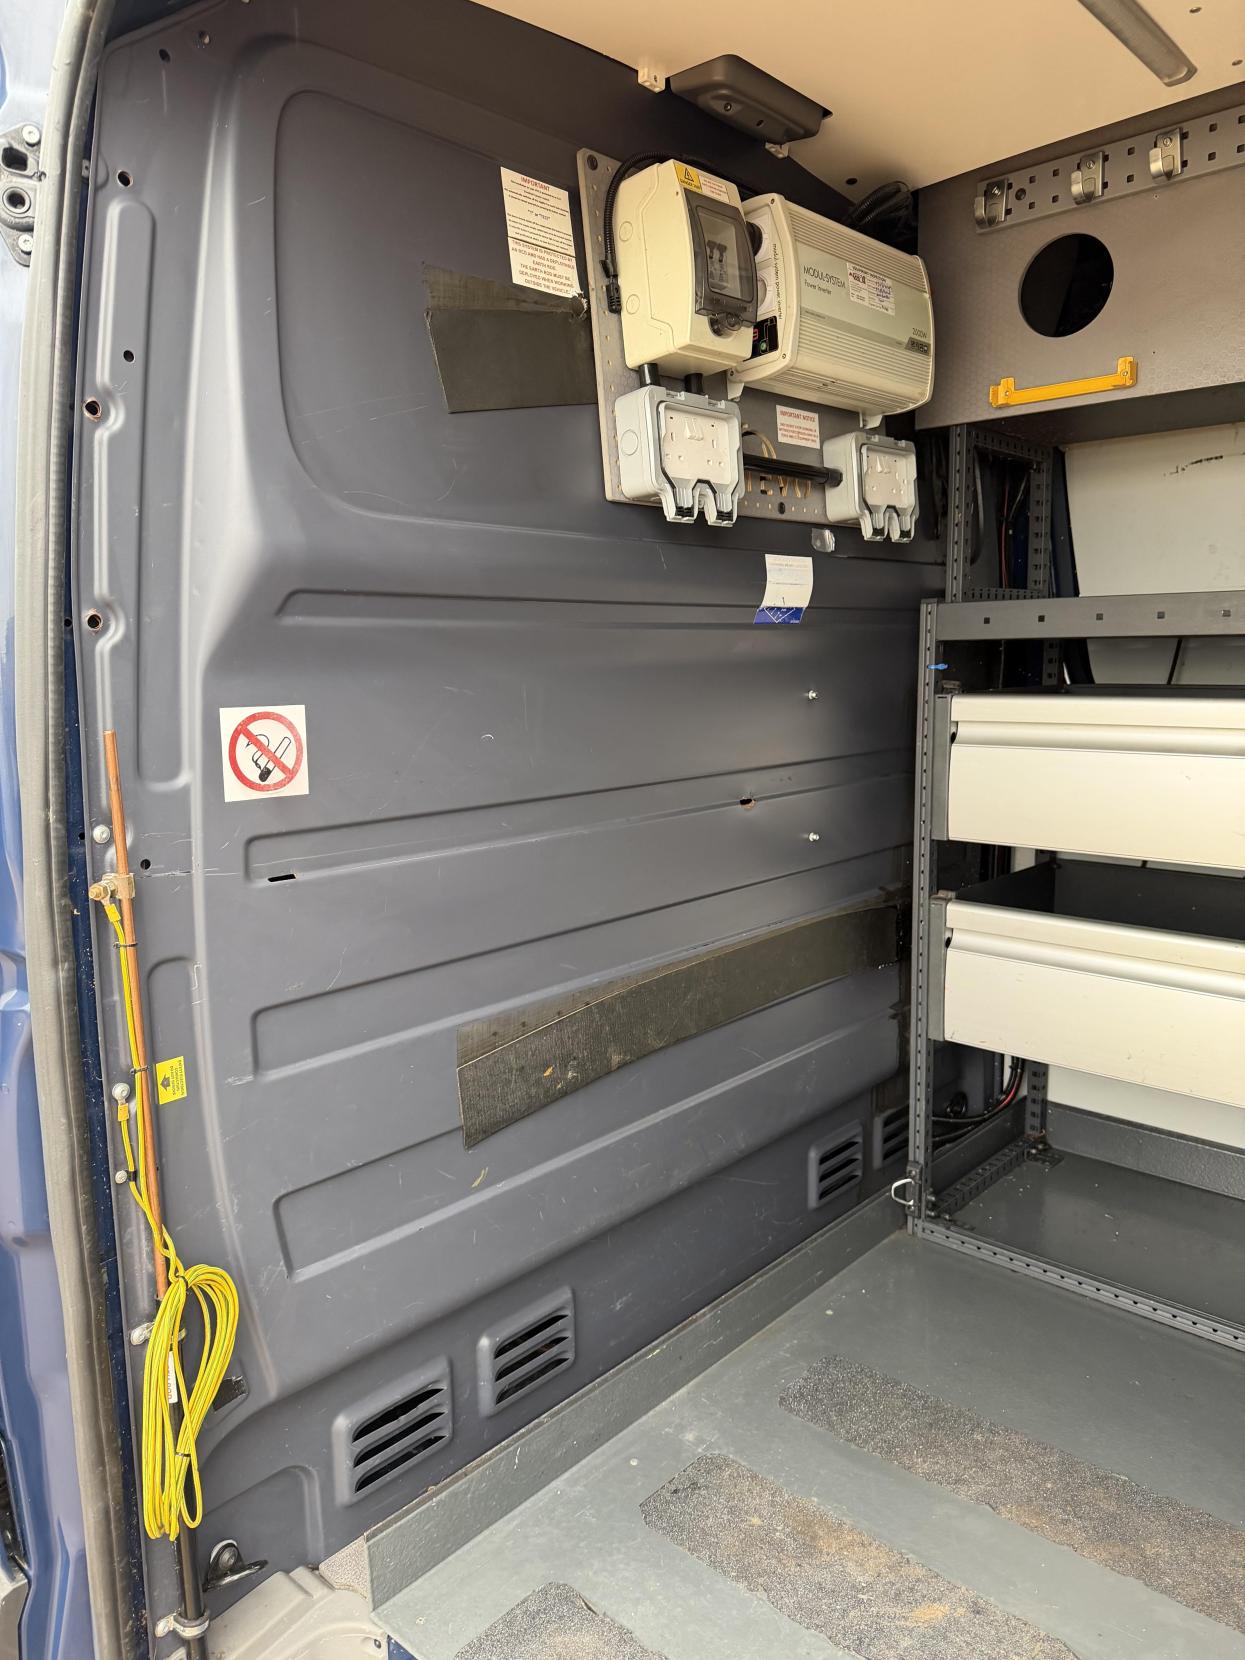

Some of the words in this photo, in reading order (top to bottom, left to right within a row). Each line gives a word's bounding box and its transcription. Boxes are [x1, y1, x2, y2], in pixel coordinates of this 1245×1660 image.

[520, 176, 549, 191] IMPORTANT
[804, 265, 846, 288] MODUL-SYSTEM
[804, 279, 816, 290] Power
